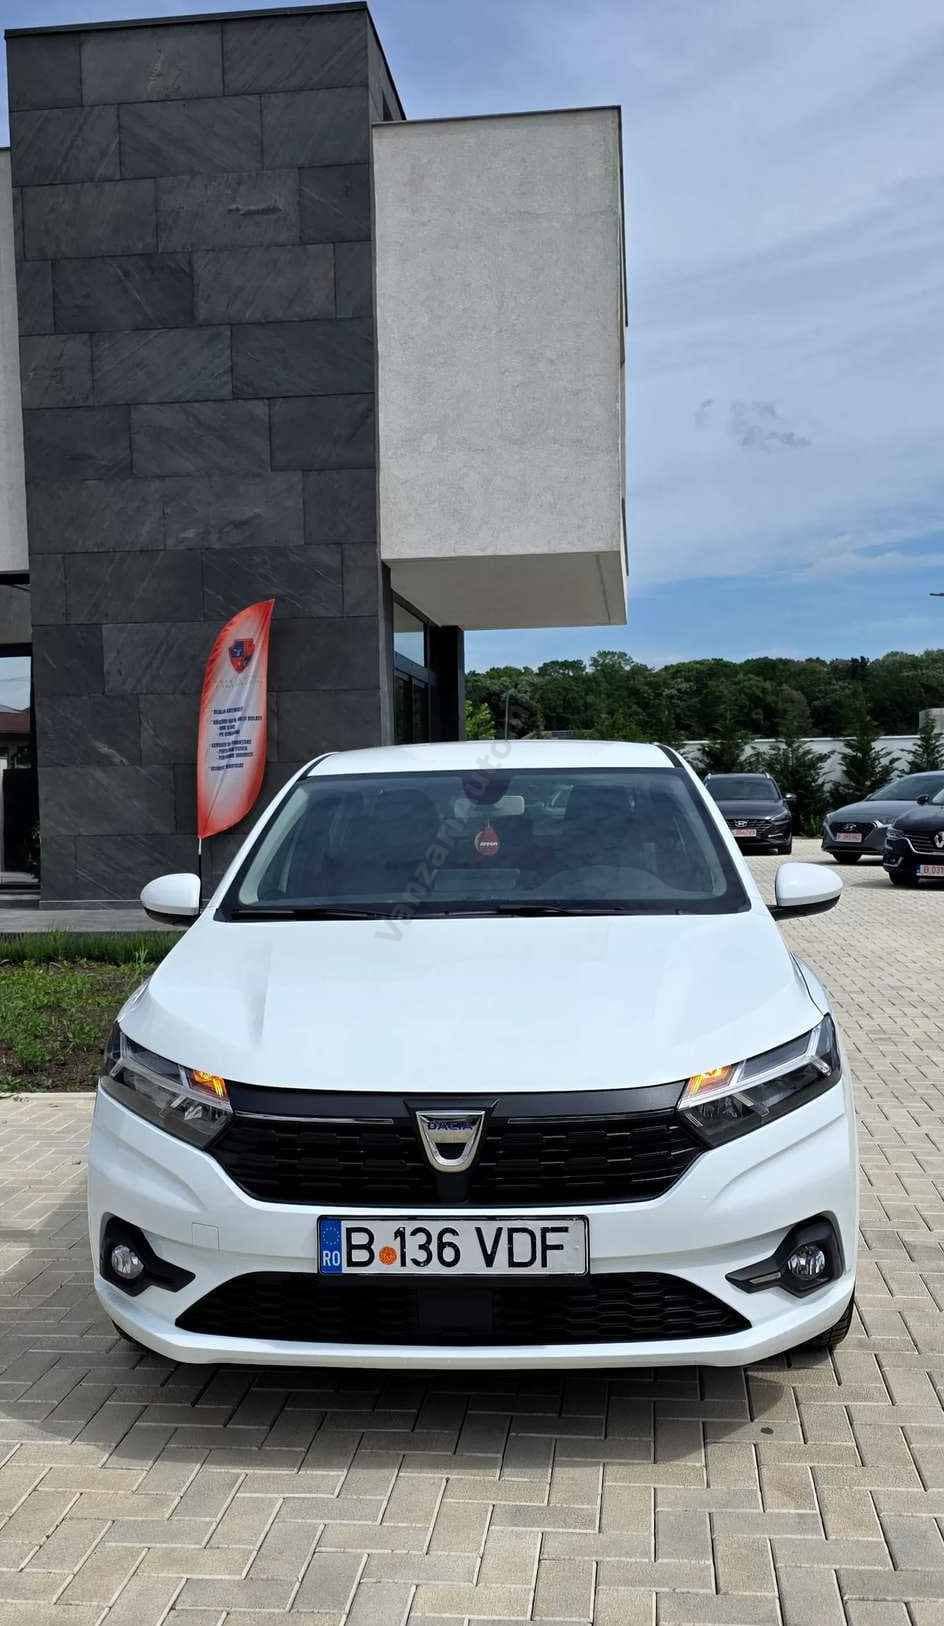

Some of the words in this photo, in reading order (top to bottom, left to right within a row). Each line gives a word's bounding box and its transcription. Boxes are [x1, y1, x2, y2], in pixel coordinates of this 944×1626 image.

[428, 1120, 473, 1130] DACIA
[345, 1226, 375, 1268] B
[393, 1226, 461, 1268] 136
[474, 1226, 569, 1268] VDF
[322, 1250, 341, 1266] RO
